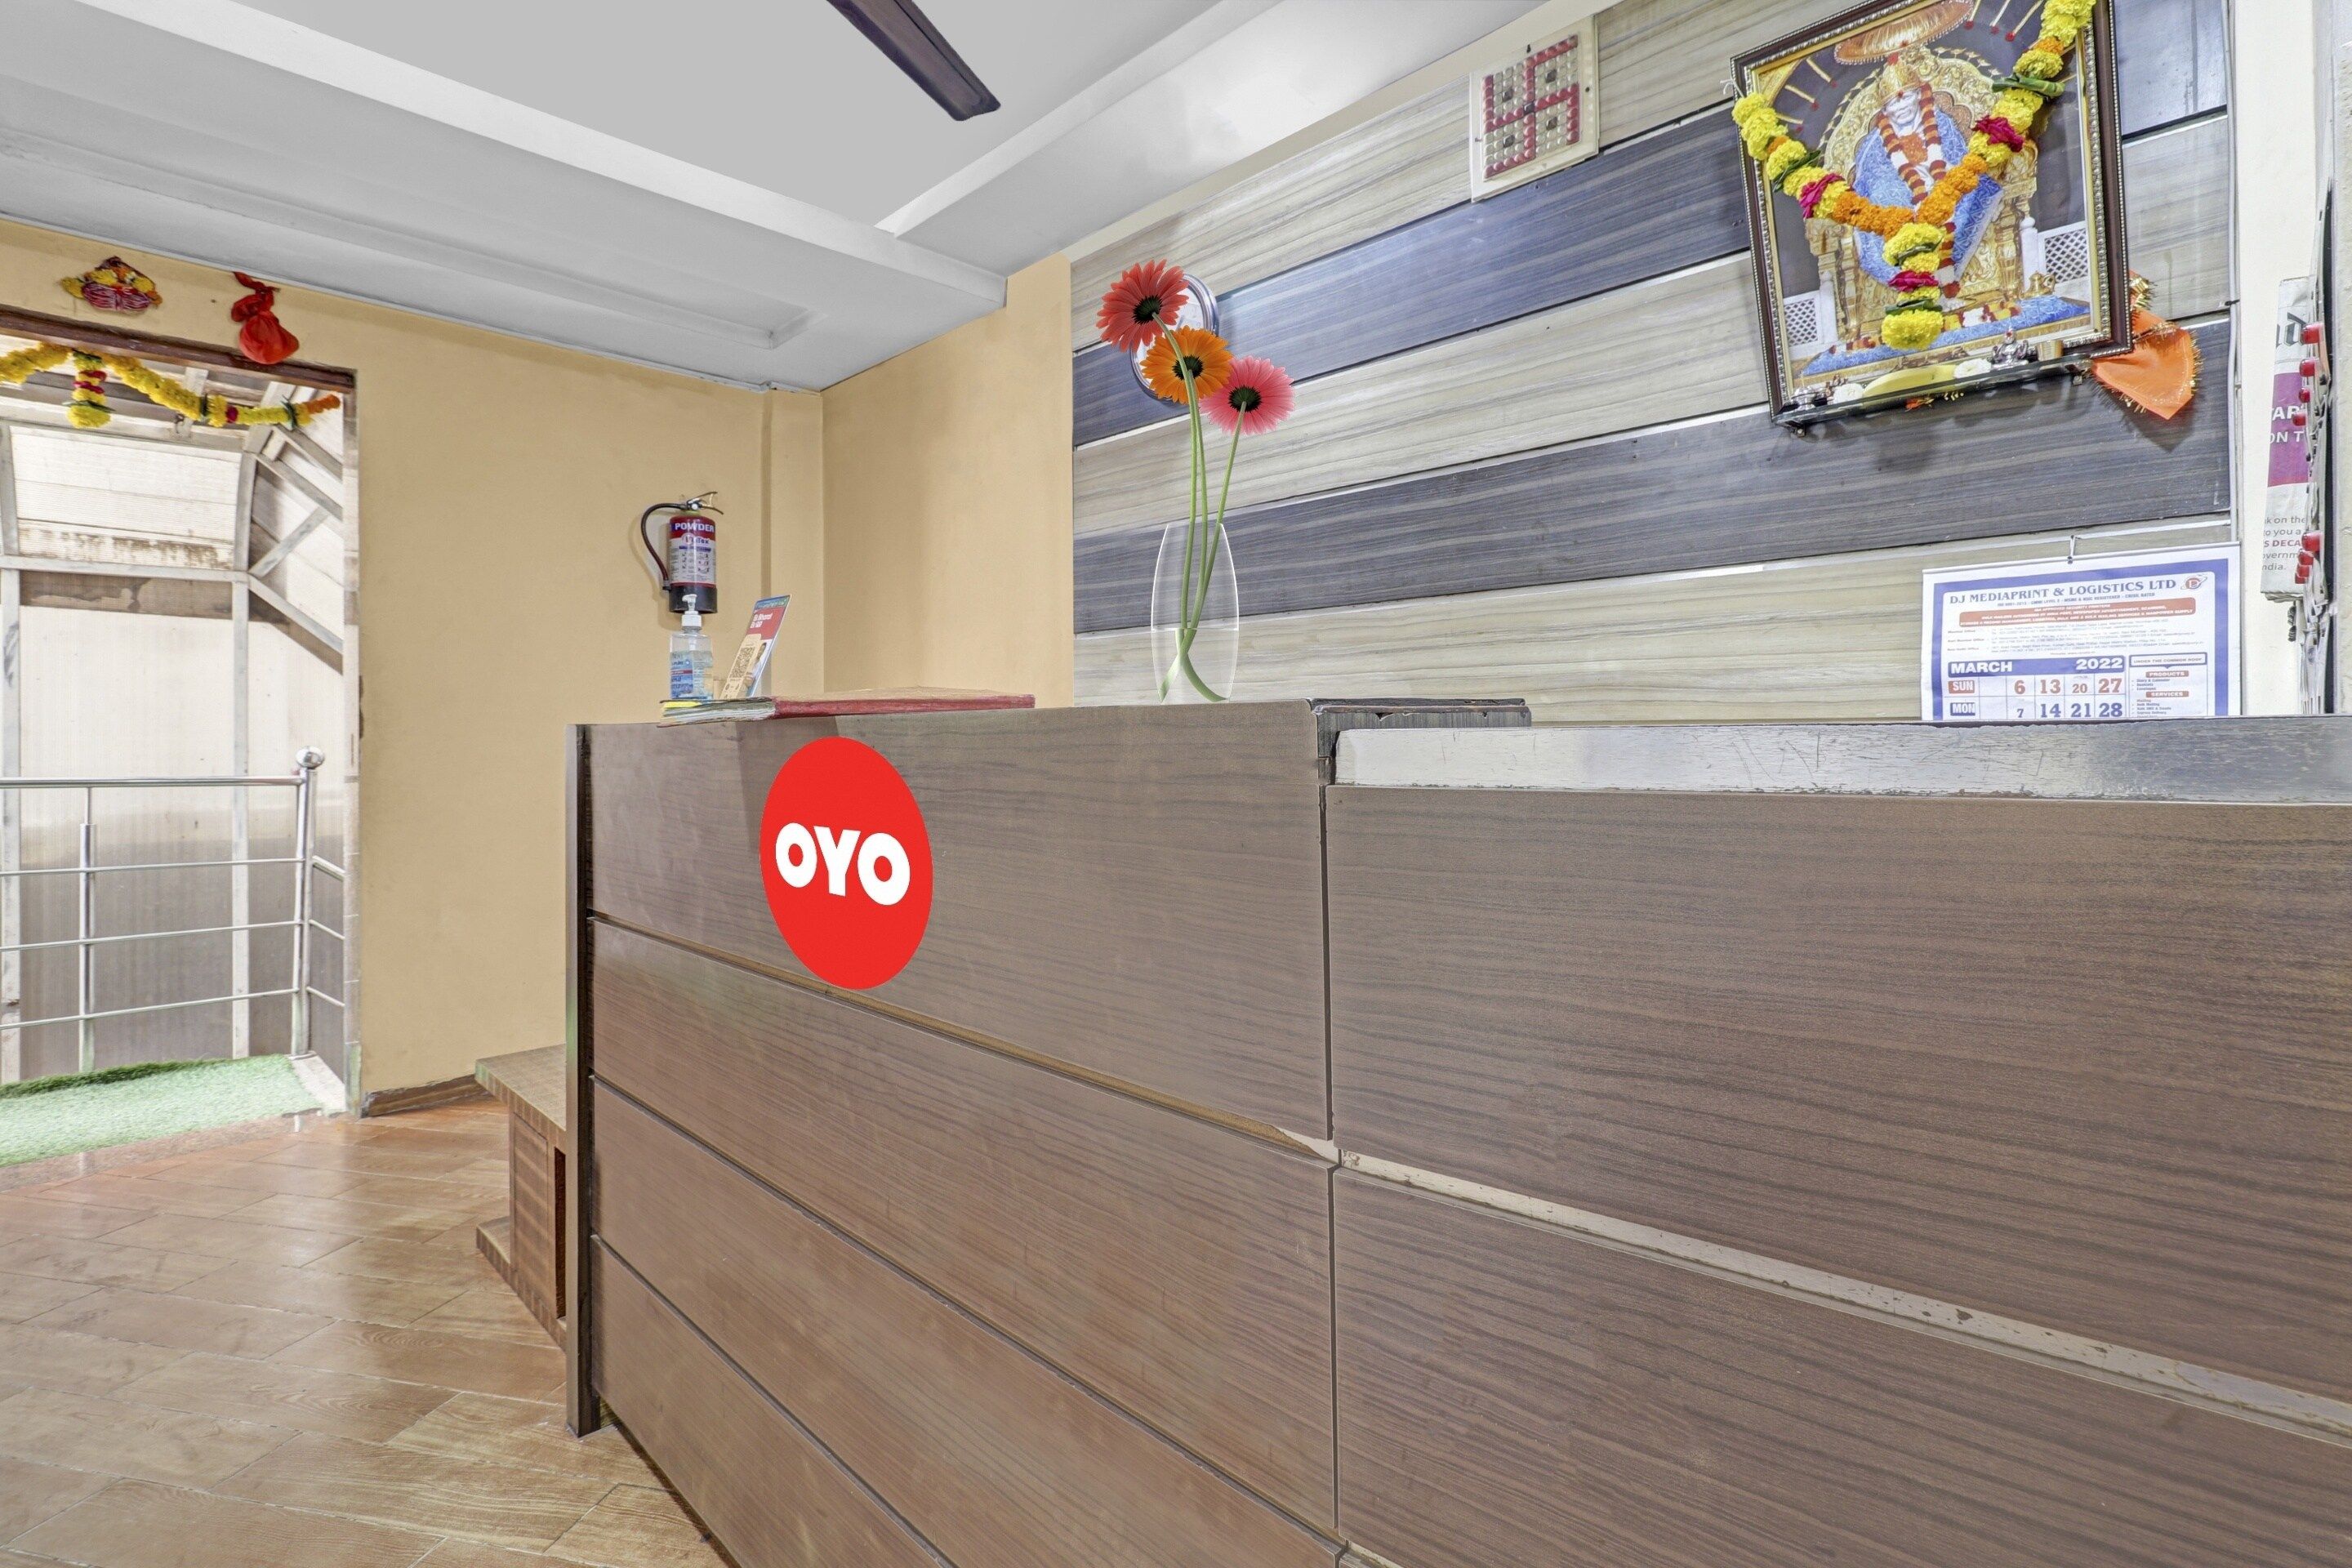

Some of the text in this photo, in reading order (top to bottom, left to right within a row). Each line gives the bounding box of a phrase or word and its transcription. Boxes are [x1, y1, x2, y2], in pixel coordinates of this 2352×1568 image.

[675, 523, 714, 532] POWDER
[1949, 580, 2176, 604] DJ MEDIAPRINT & LOGISTICS LTD
[1950, 658, 2123, 674] MARCH 2022
[1953, 678, 2122, 694] SUN 6 13 20 27
[1953, 703, 2123, 718] MON 7 14 21 28
[776, 822, 911, 906] OYO
